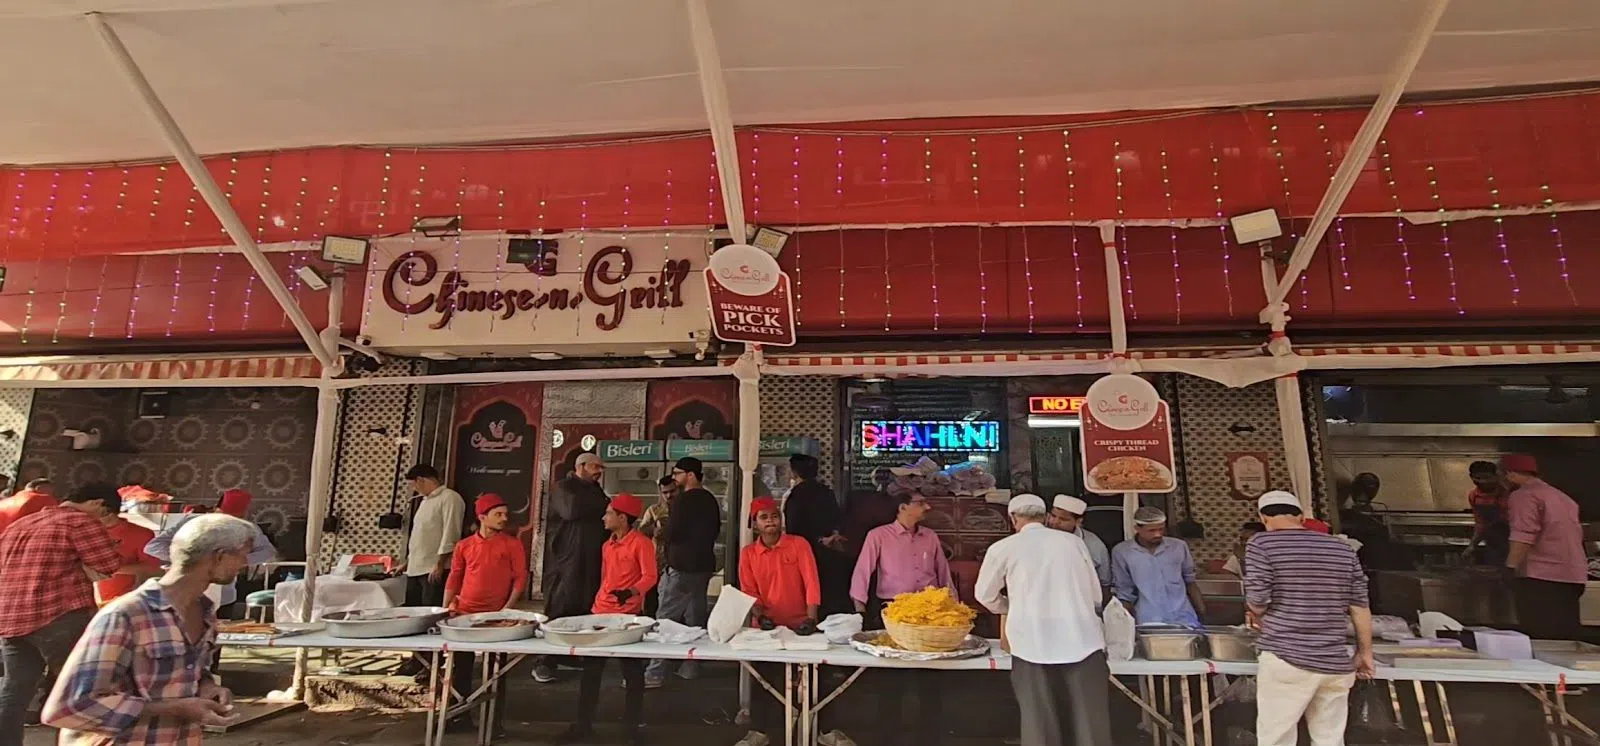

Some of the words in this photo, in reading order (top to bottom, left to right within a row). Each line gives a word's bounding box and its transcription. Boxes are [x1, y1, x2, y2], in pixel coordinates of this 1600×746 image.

[383, 250, 534, 329] Chinese
[584, 245, 691, 331] Grill
[720, 302, 763, 313] BEWARE
[765, 306, 781, 314] OF
[723, 310, 782, 327] PICK
[723, 323, 784, 335] POCKETS
[1042, 399, 1068, 410] NO
[607, 442, 653, 458] Bisleri
[760, 438, 790, 451] isleri
